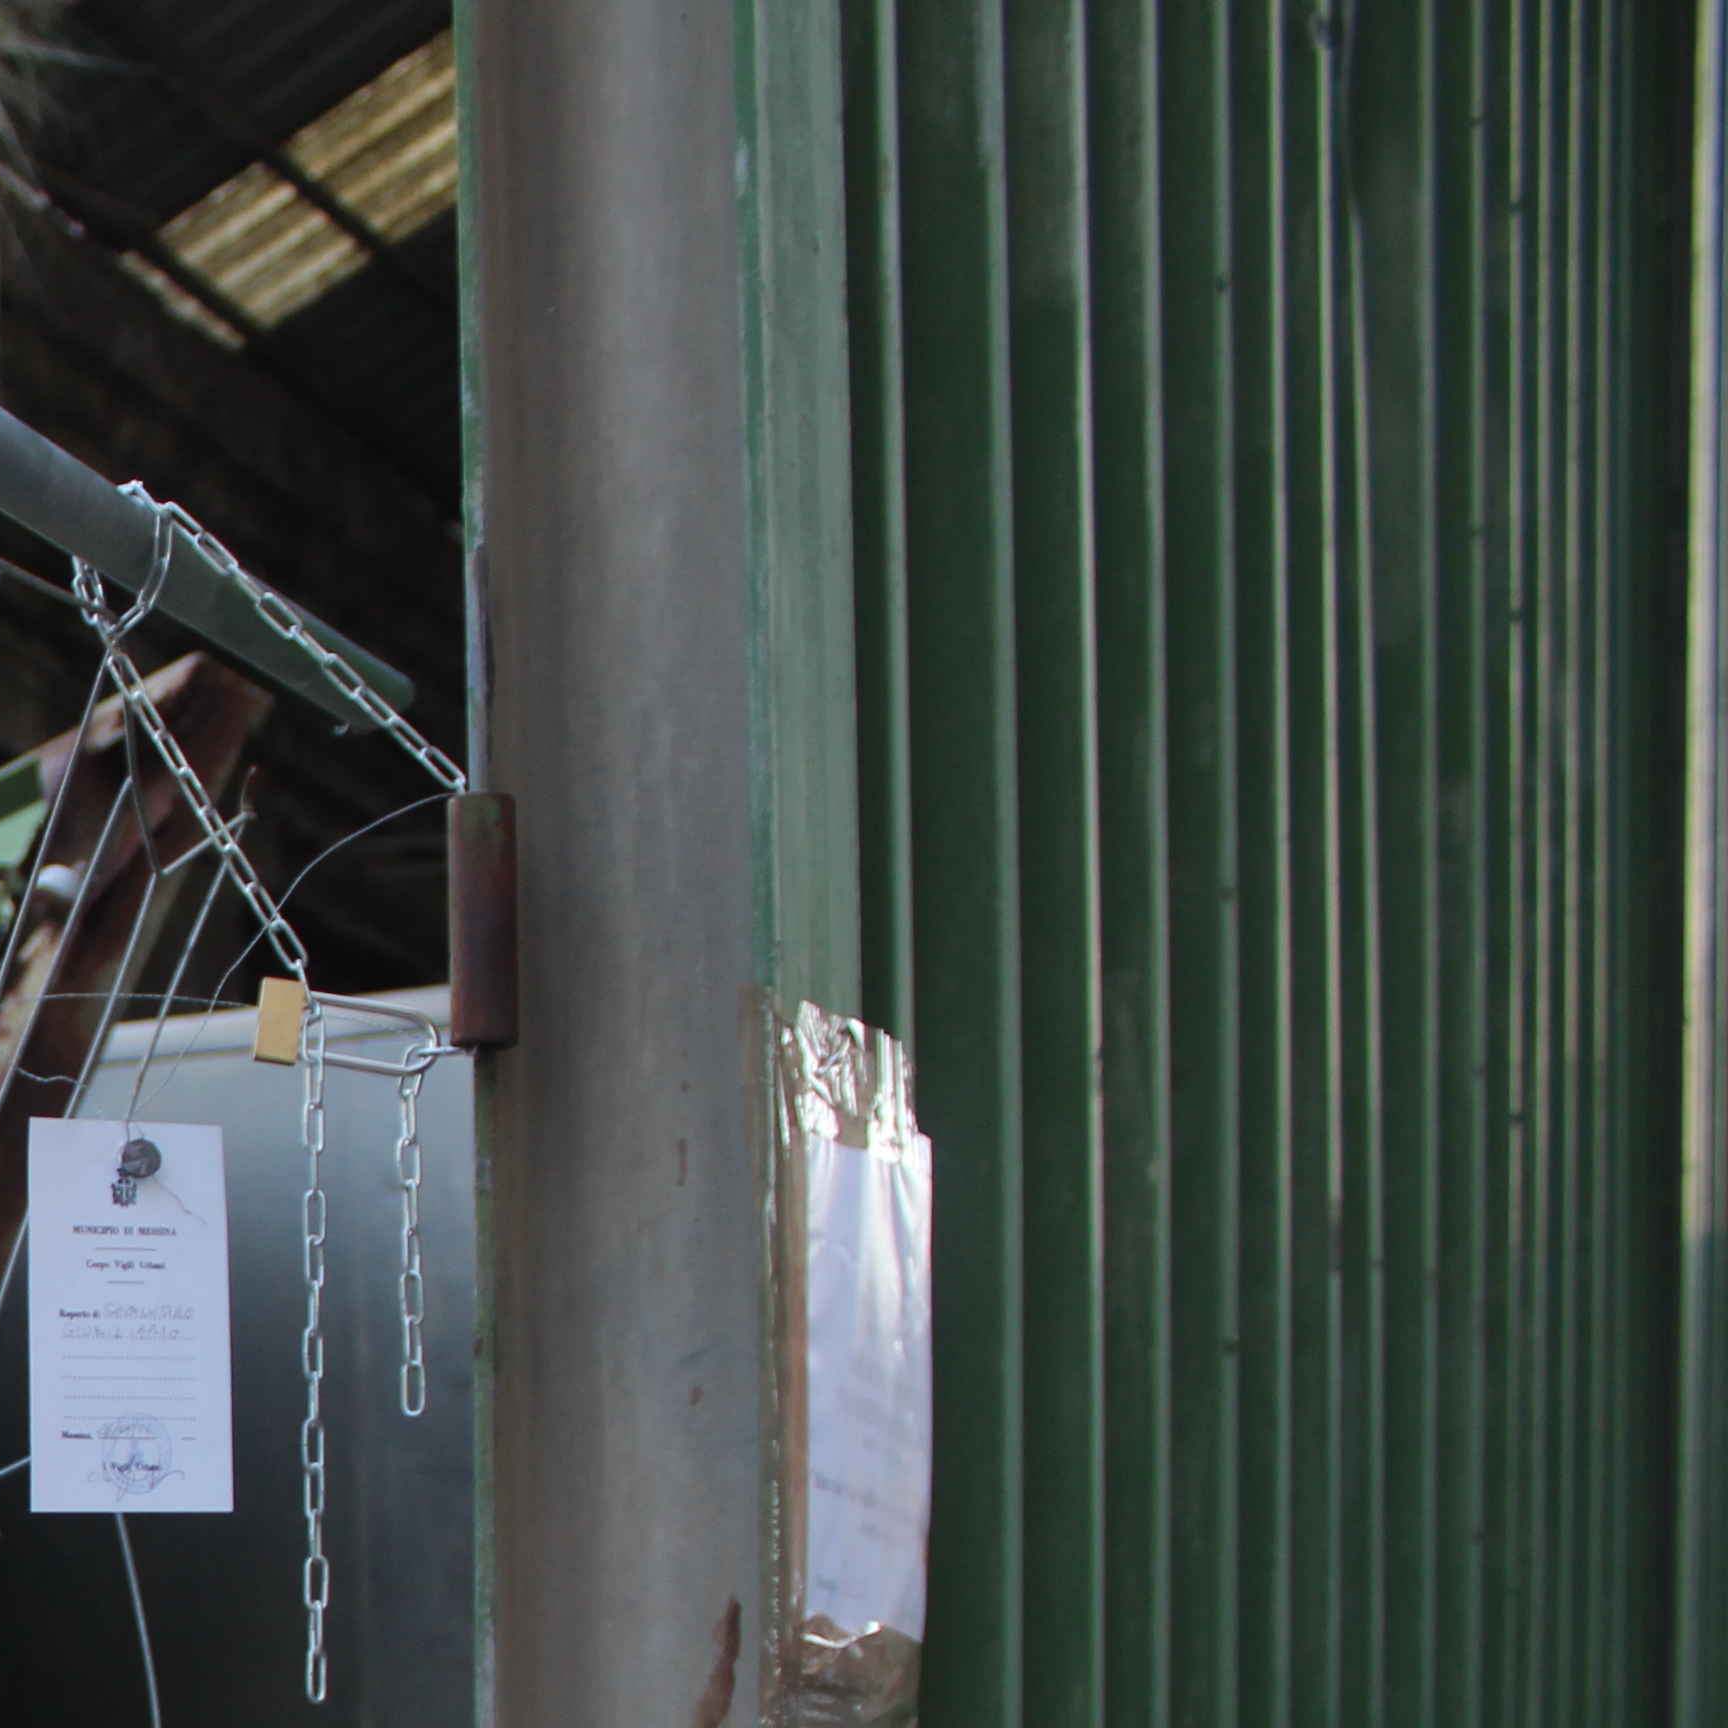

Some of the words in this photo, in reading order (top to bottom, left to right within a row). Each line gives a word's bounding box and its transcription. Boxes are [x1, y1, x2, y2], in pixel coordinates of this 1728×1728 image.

[72, 1224, 120, 1235] MUNICIPIO
[124, 1226, 134, 1236] DI
[138, 1226, 177, 1237] MESSINA
